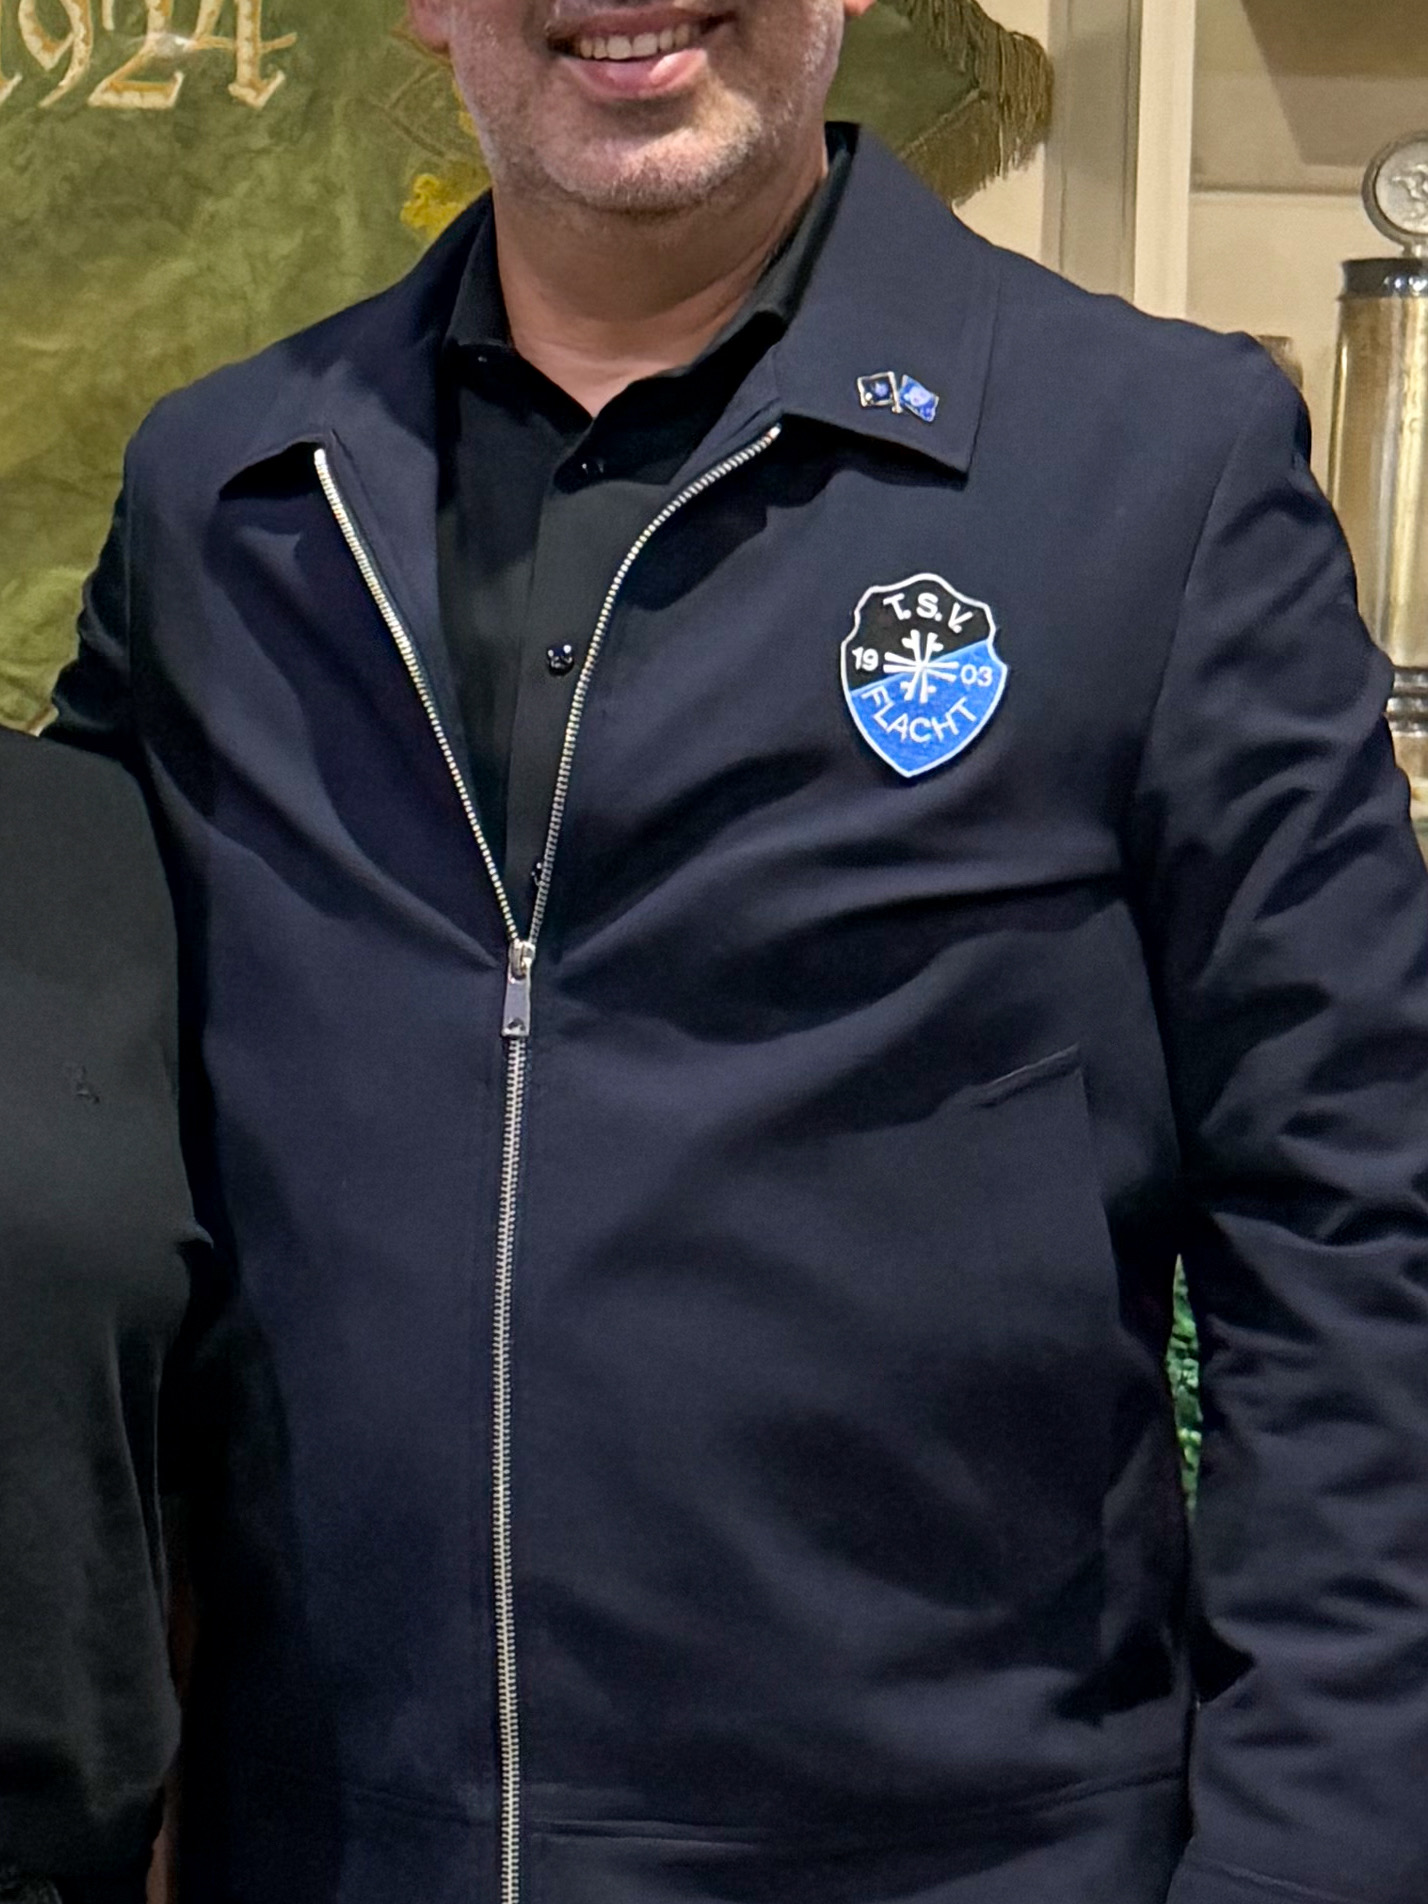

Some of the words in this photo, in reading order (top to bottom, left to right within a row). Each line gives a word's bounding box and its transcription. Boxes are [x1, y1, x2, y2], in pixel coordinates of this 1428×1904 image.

[852, 645, 879, 672] 19
[960, 663, 993, 687] 03
[862, 686, 977, 743] FLACHT
